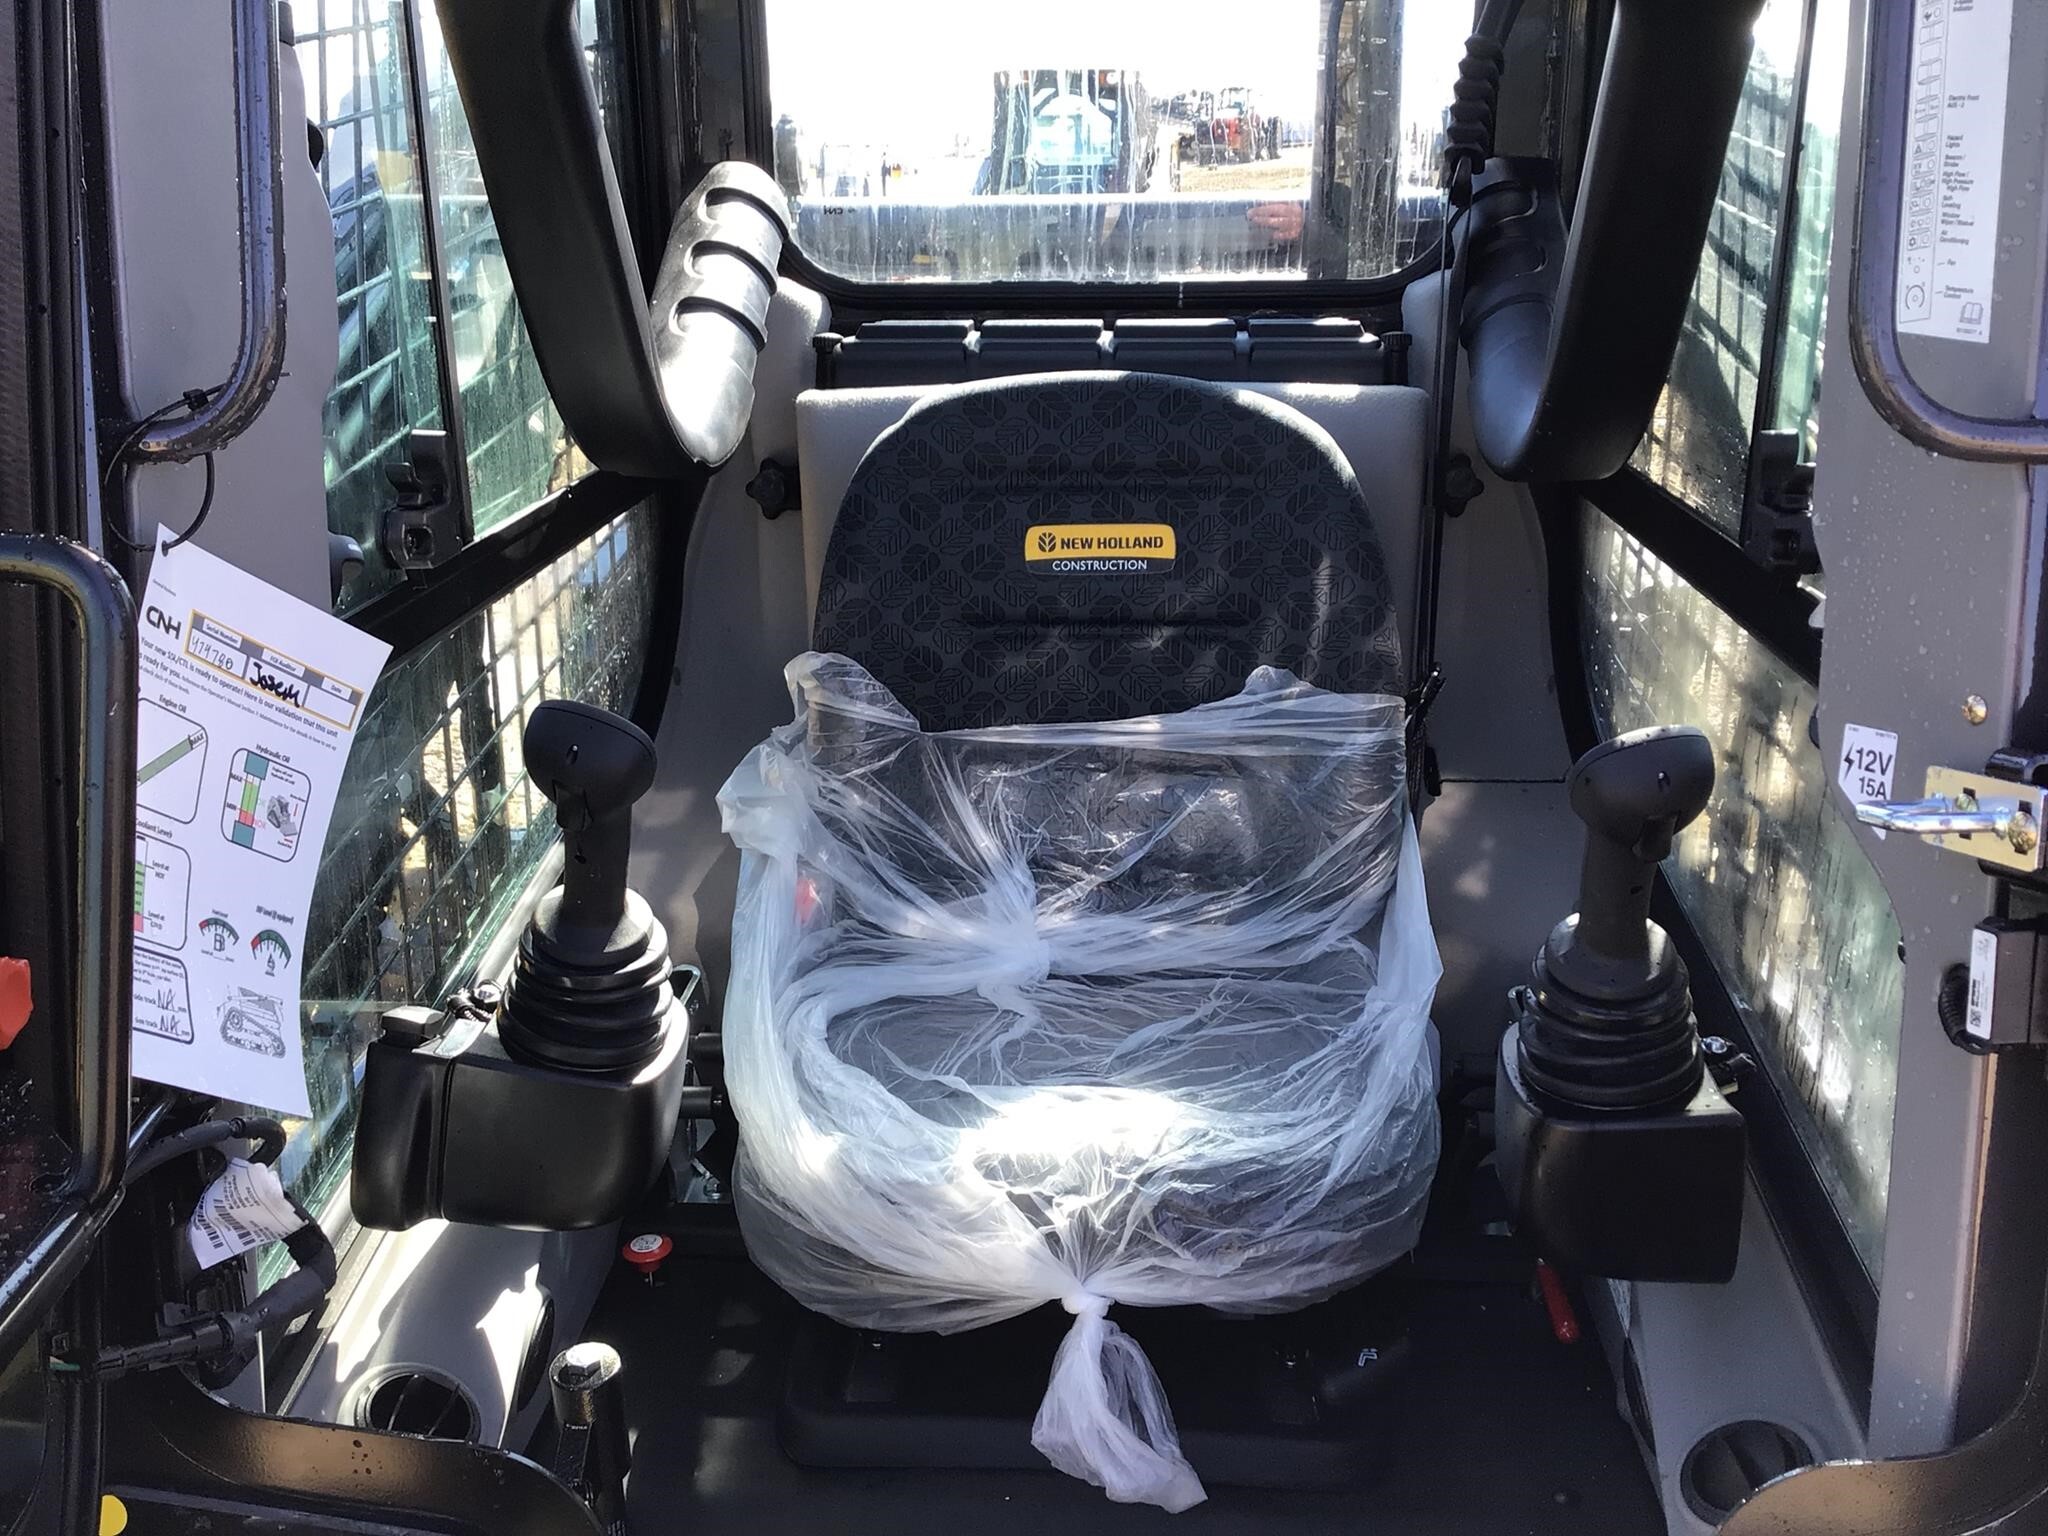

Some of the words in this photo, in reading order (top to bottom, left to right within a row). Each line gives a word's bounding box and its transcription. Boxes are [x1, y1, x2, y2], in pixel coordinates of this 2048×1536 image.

[1060, 537, 1094, 550] NEW
[1097, 536, 1164, 549] HOLLAND
[1052, 559, 1147, 571] CONSTRUCTION
[146, 605, 182, 640] CNH
[143, 654, 160, 669] ready
[160, 661, 169, 672] for
[159, 694, 178, 710] Engine
[178, 703, 187, 714] Oil
[195, 667, 211, 681] ready
[243, 690, 258, 702] Here
[264, 700, 275, 710] our
[275, 706, 303, 722] validation
[303, 717, 315, 729] that
[315, 722, 326, 733] this
[326, 728, 338, 738] unit
[256, 743, 281, 761] Hydraulic
[281, 754, 291, 764] Oil
[1856, 747, 1893, 776] 12V
[1859, 776, 1886, 800] 15A
